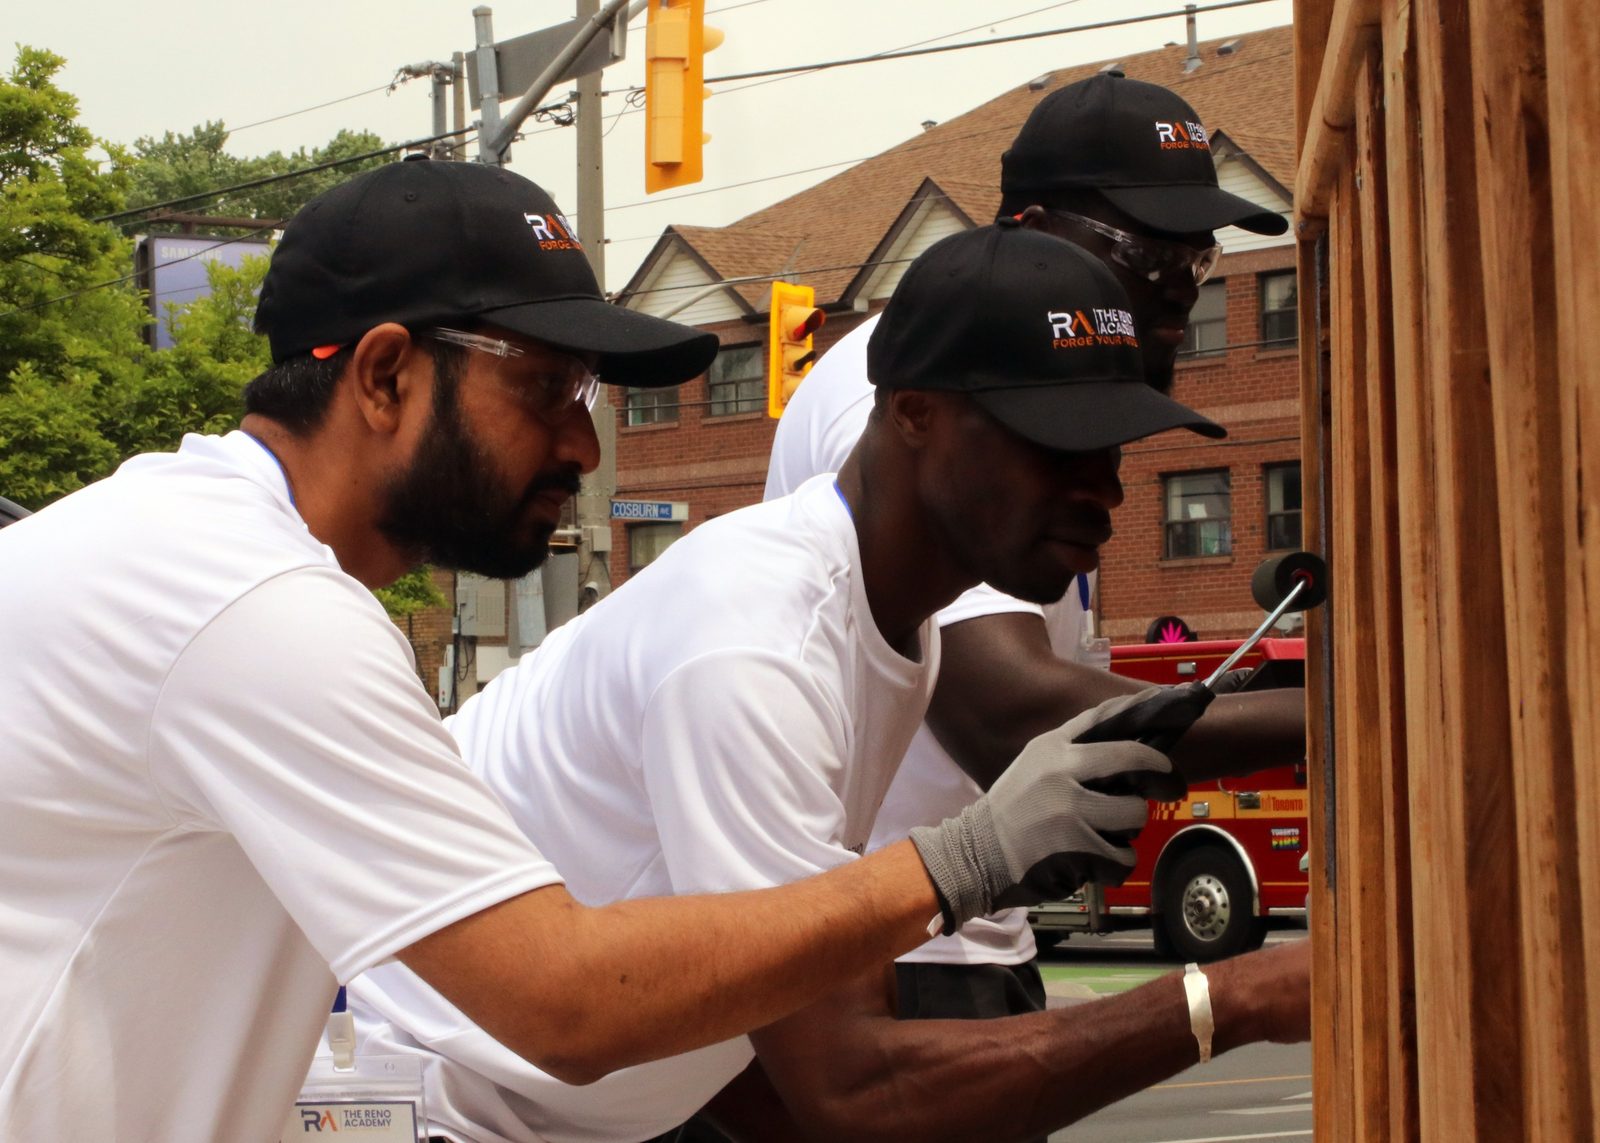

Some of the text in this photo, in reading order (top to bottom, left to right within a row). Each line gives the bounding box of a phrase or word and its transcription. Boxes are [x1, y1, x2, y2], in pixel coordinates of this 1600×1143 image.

[1160, 142, 1190, 150] FORGE
[540, 240, 572, 251] FORGE
[161, 246, 222, 261] SAMSUNG
[1096, 308, 1119, 322] THE
[1053, 336, 1093, 349] FORGE
[1095, 335, 1122, 345] YOUR
[612, 502, 658, 517] COSBURN
[344, 1109, 391, 1118] THE RENO
[344, 1118, 391, 1127] ACADEMY
